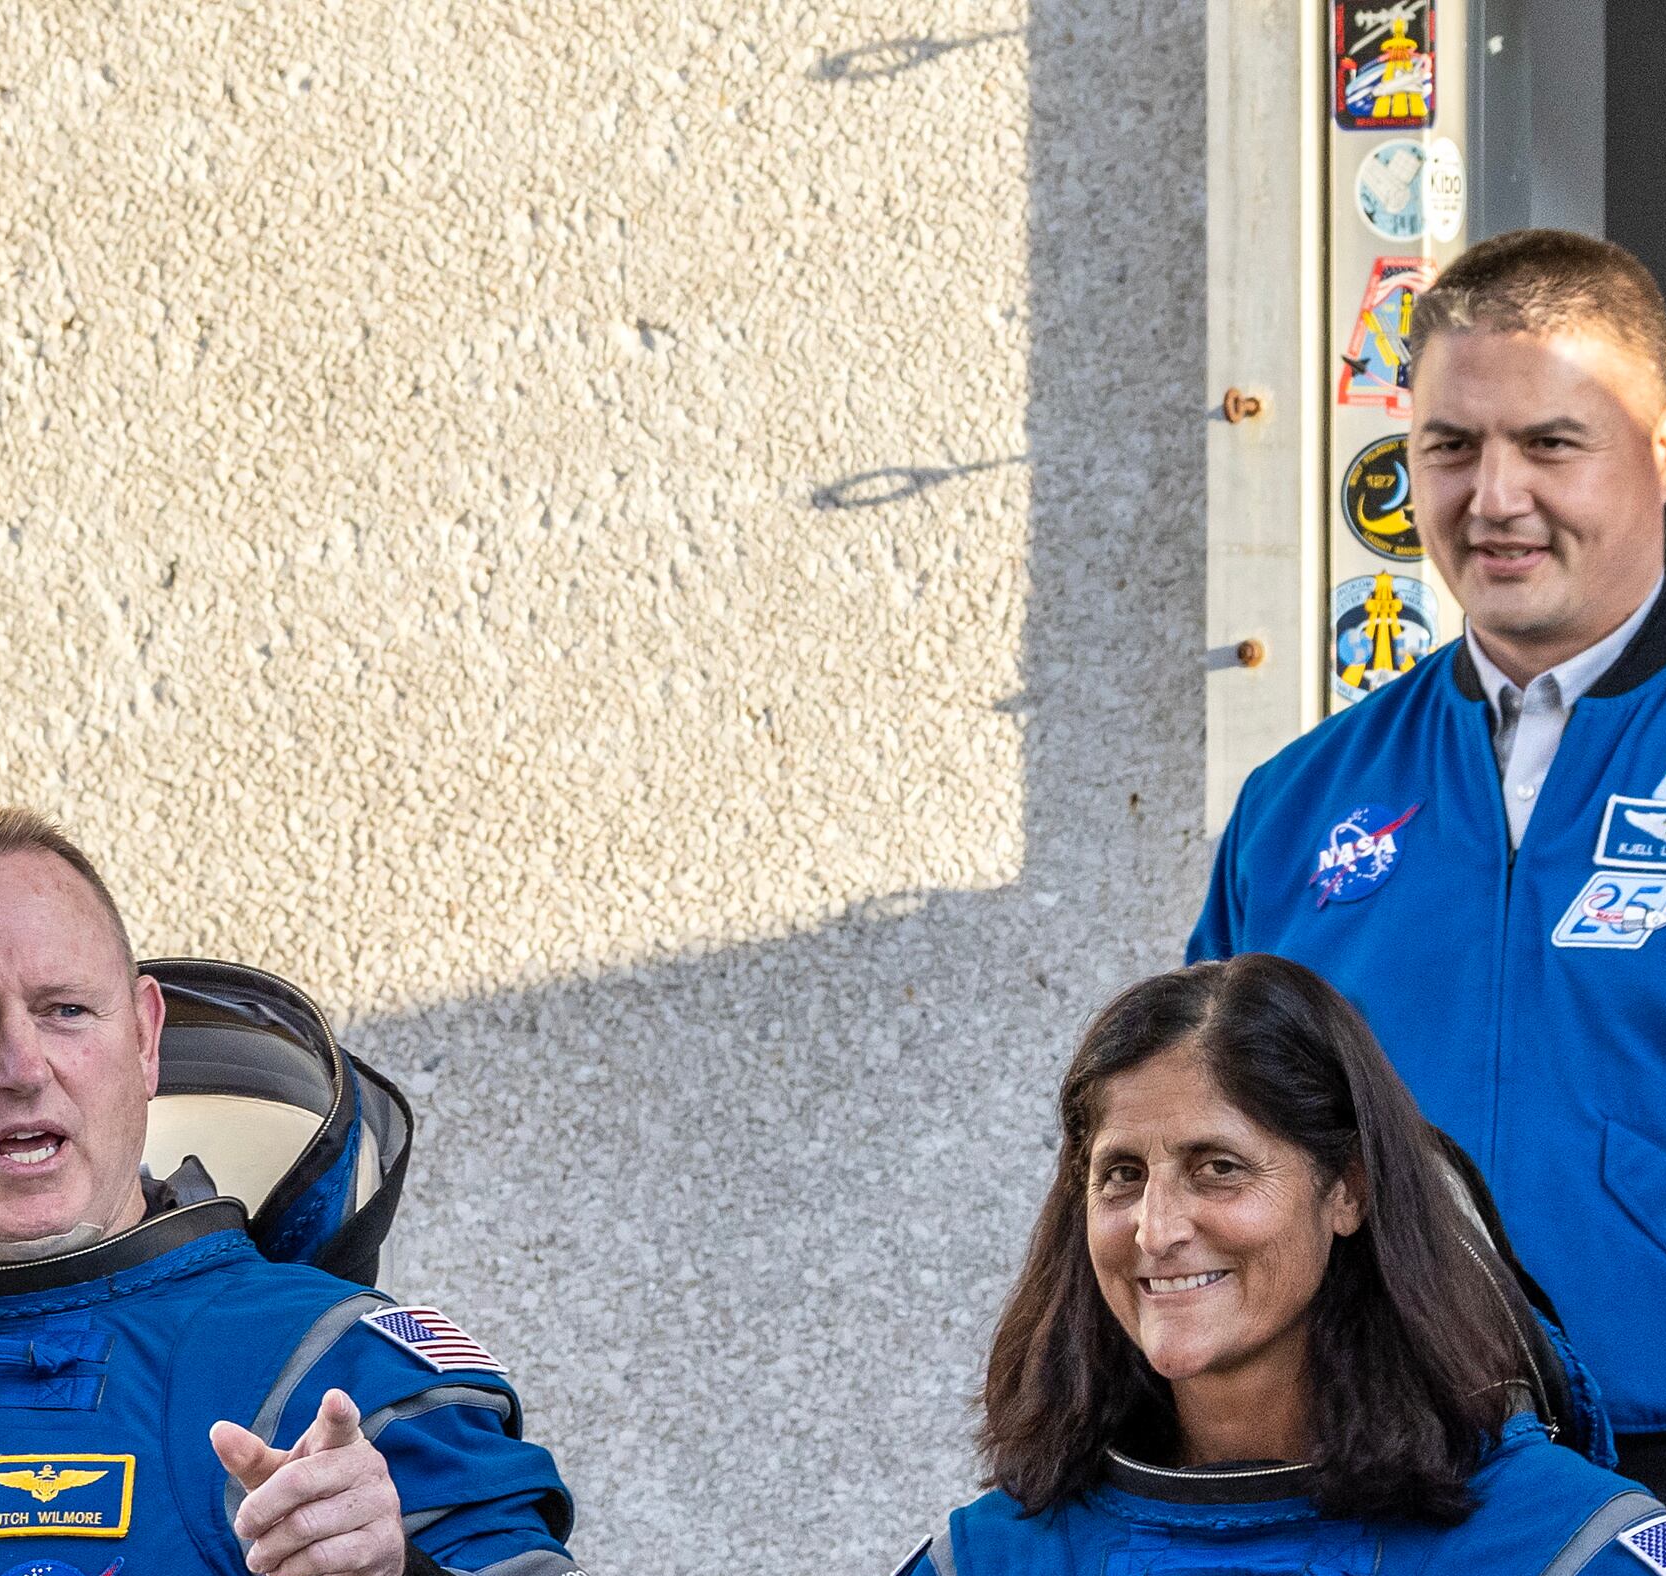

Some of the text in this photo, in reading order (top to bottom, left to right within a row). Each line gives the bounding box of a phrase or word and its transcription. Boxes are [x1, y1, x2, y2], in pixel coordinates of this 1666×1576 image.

[1431, 171, 1462, 195] Kibo
[1365, 474, 1397, 489] 127
[1318, 833, 1397, 872] NASA
[1617, 842, 1654, 857] KJELL
[1571, 882, 1664, 935] 25
[37, 1511, 103, 1525] WILMORE
